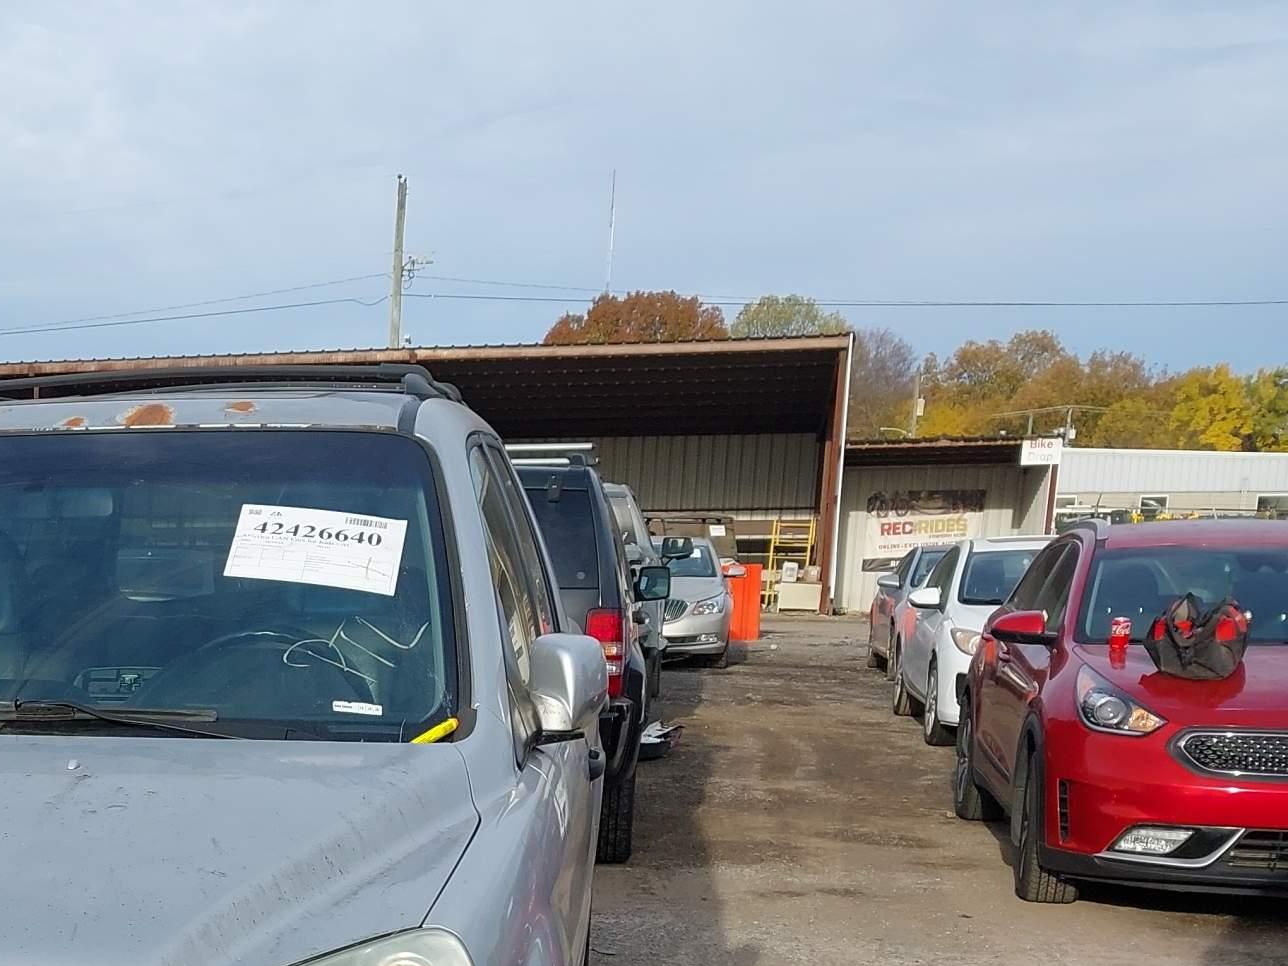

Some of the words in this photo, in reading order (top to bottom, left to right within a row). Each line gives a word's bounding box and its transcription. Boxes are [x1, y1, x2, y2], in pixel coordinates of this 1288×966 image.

[1030, 439, 1054, 449] Bike
[253, 521, 382, 547] 42426640
[880, 521, 913, 536] REC
[918, 517, 968, 534] RIDES
